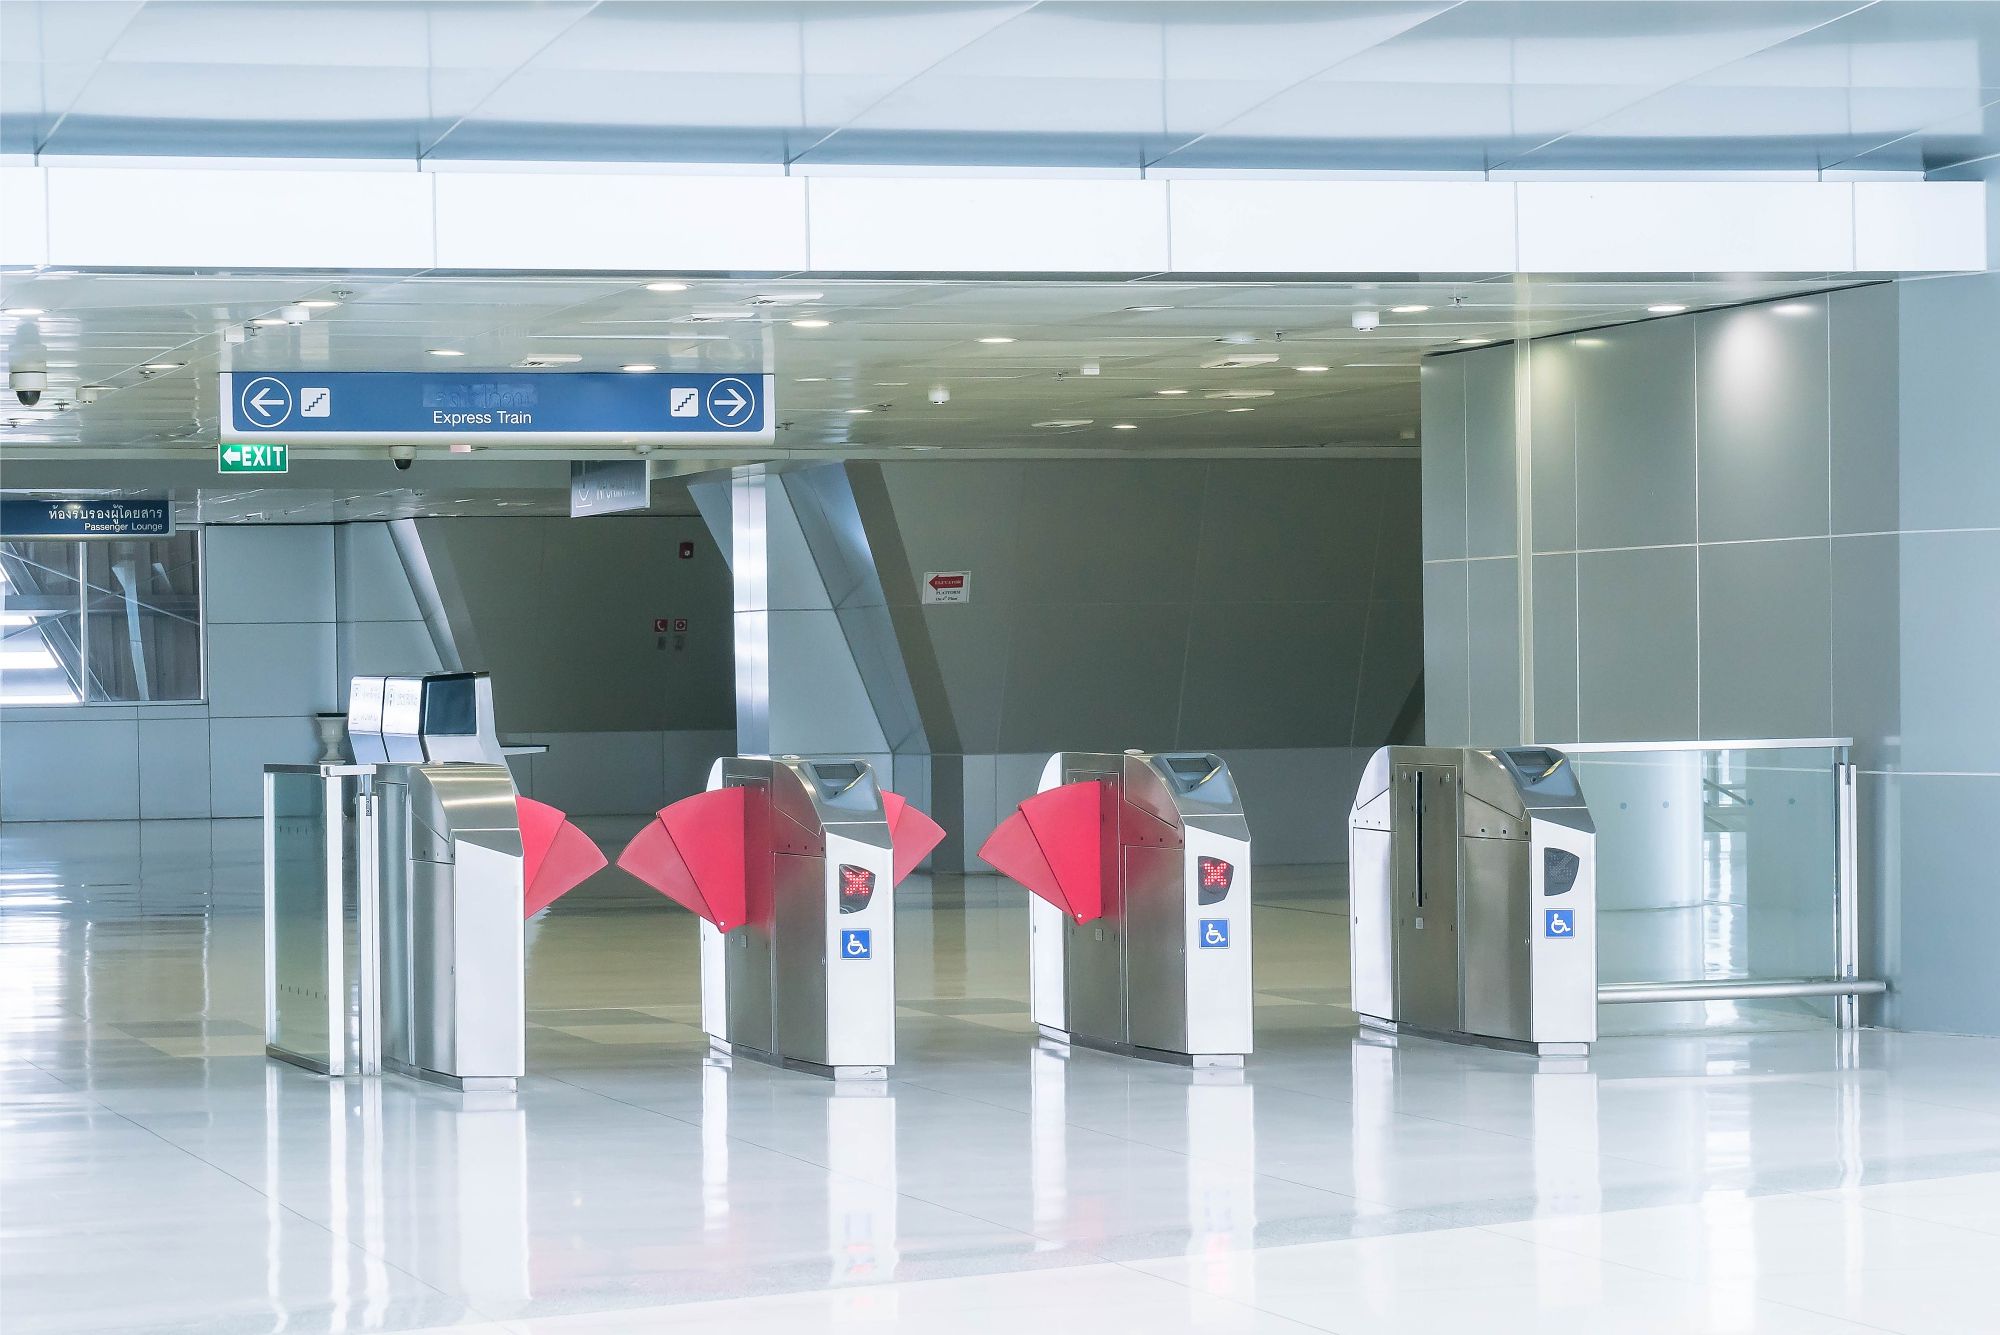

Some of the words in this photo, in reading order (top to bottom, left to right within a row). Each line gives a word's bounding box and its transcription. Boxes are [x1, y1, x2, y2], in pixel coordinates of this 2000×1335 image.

[433, 410, 492, 427] Express
[497, 410, 532, 424] Train
[242, 446, 284, 467] EXIT
[84, 523, 128, 532] Passenger
[131, 522, 162, 531] Lounge
